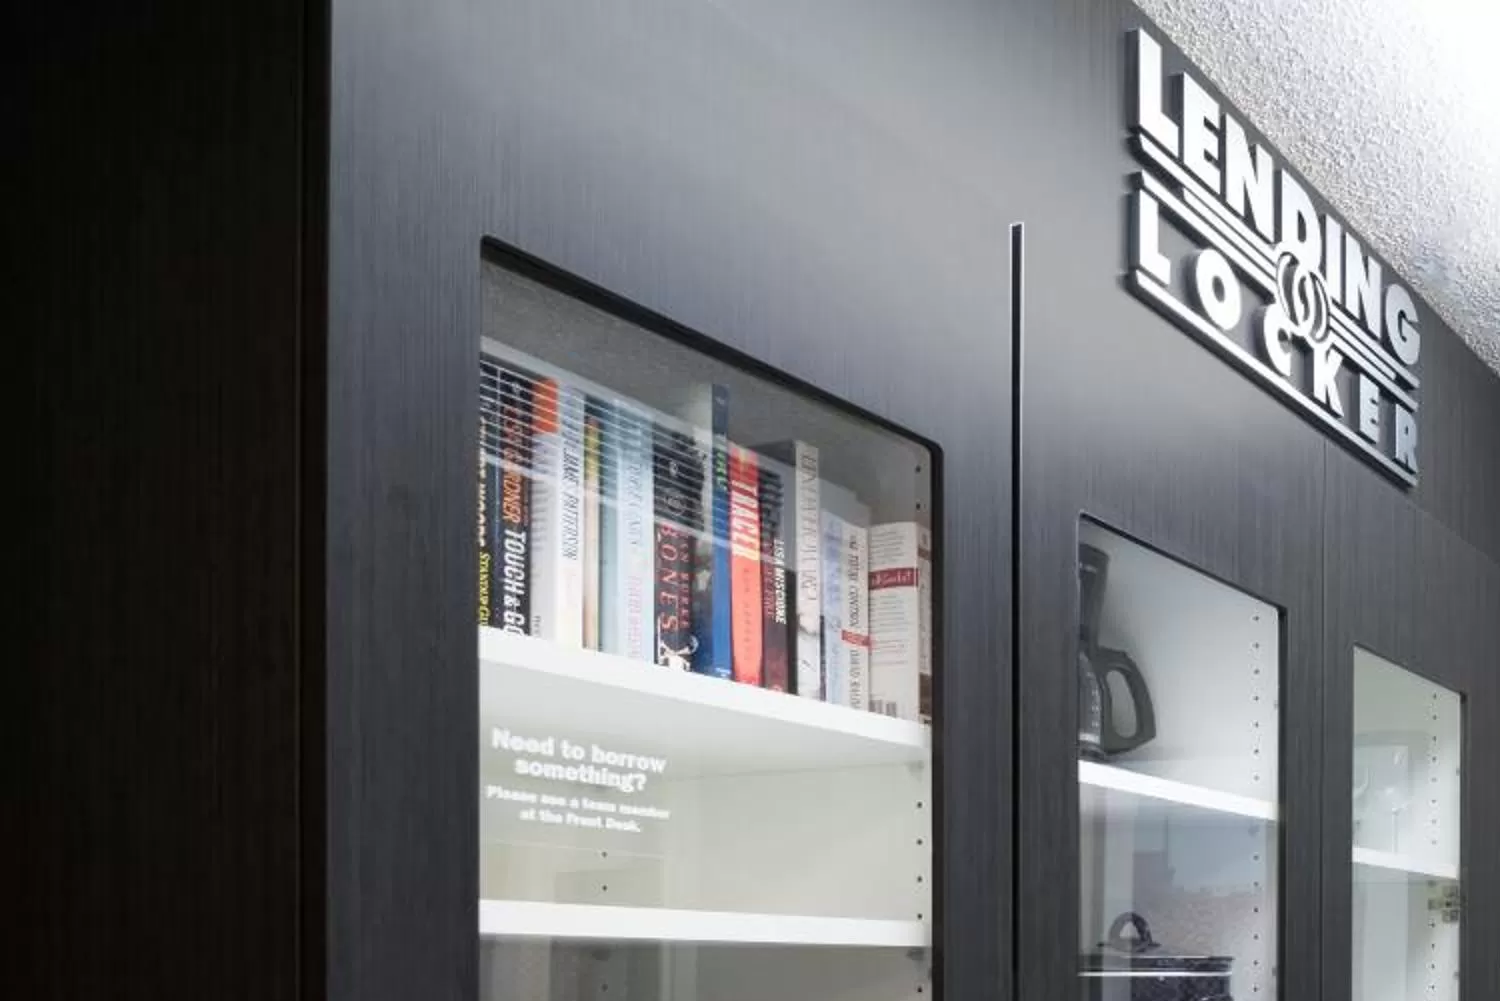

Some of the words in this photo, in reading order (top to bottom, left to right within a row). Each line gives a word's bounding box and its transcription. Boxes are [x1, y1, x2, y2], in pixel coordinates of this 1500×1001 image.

[1138, 27, 1421, 366] LENDING
[1137, 188, 1418, 474] LOCKER
[561, 494, 579, 561] PATTERSON
[730, 479, 759, 562] TRACER
[773, 539, 786, 566] LISA
[503, 529, 527, 596] TOUCH
[660, 523, 679, 632] BONES
[504, 595, 520, 608] &
[491, 727, 555, 757] Need
[561, 739, 585, 761] to
[591, 744, 667, 774] borrow
[514, 758, 647, 794] something?
